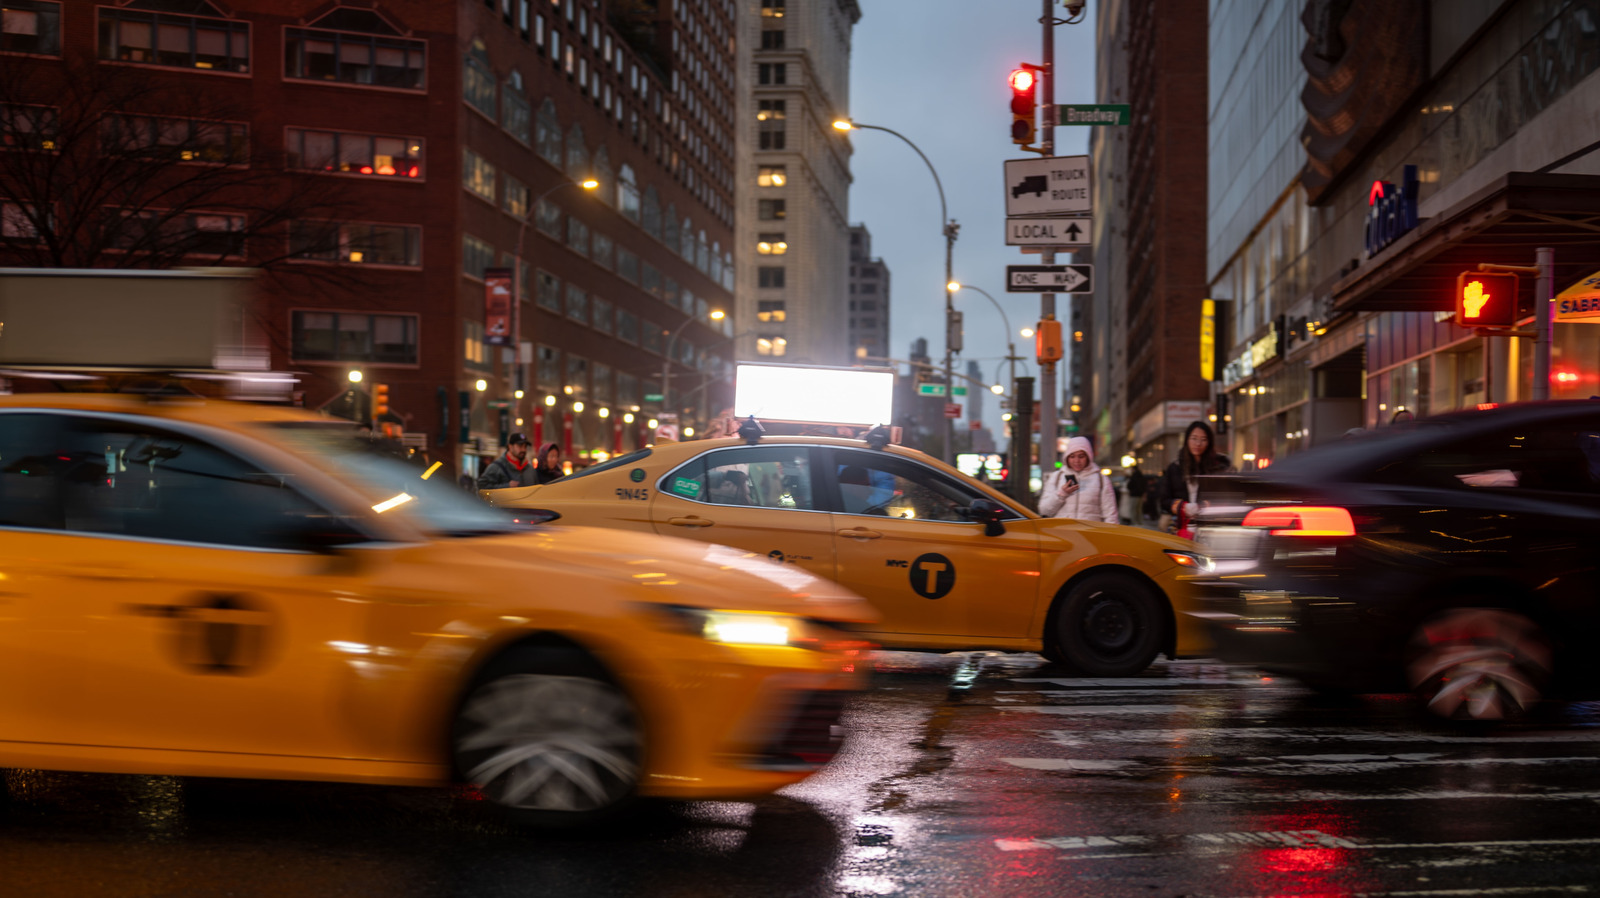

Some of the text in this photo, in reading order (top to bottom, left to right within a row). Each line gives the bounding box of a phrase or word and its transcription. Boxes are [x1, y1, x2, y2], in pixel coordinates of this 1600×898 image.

[1067, 108, 1121, 125] Broadway
[1051, 169, 1085, 181] TRUCK
[1051, 188, 1087, 200] ROUTE
[1013, 225, 1058, 239] LOCAL
[1015, 273, 1078, 284] ONE WAY
[676, 480, 700, 490] curb
[885, 559, 947, 594] NYC T
